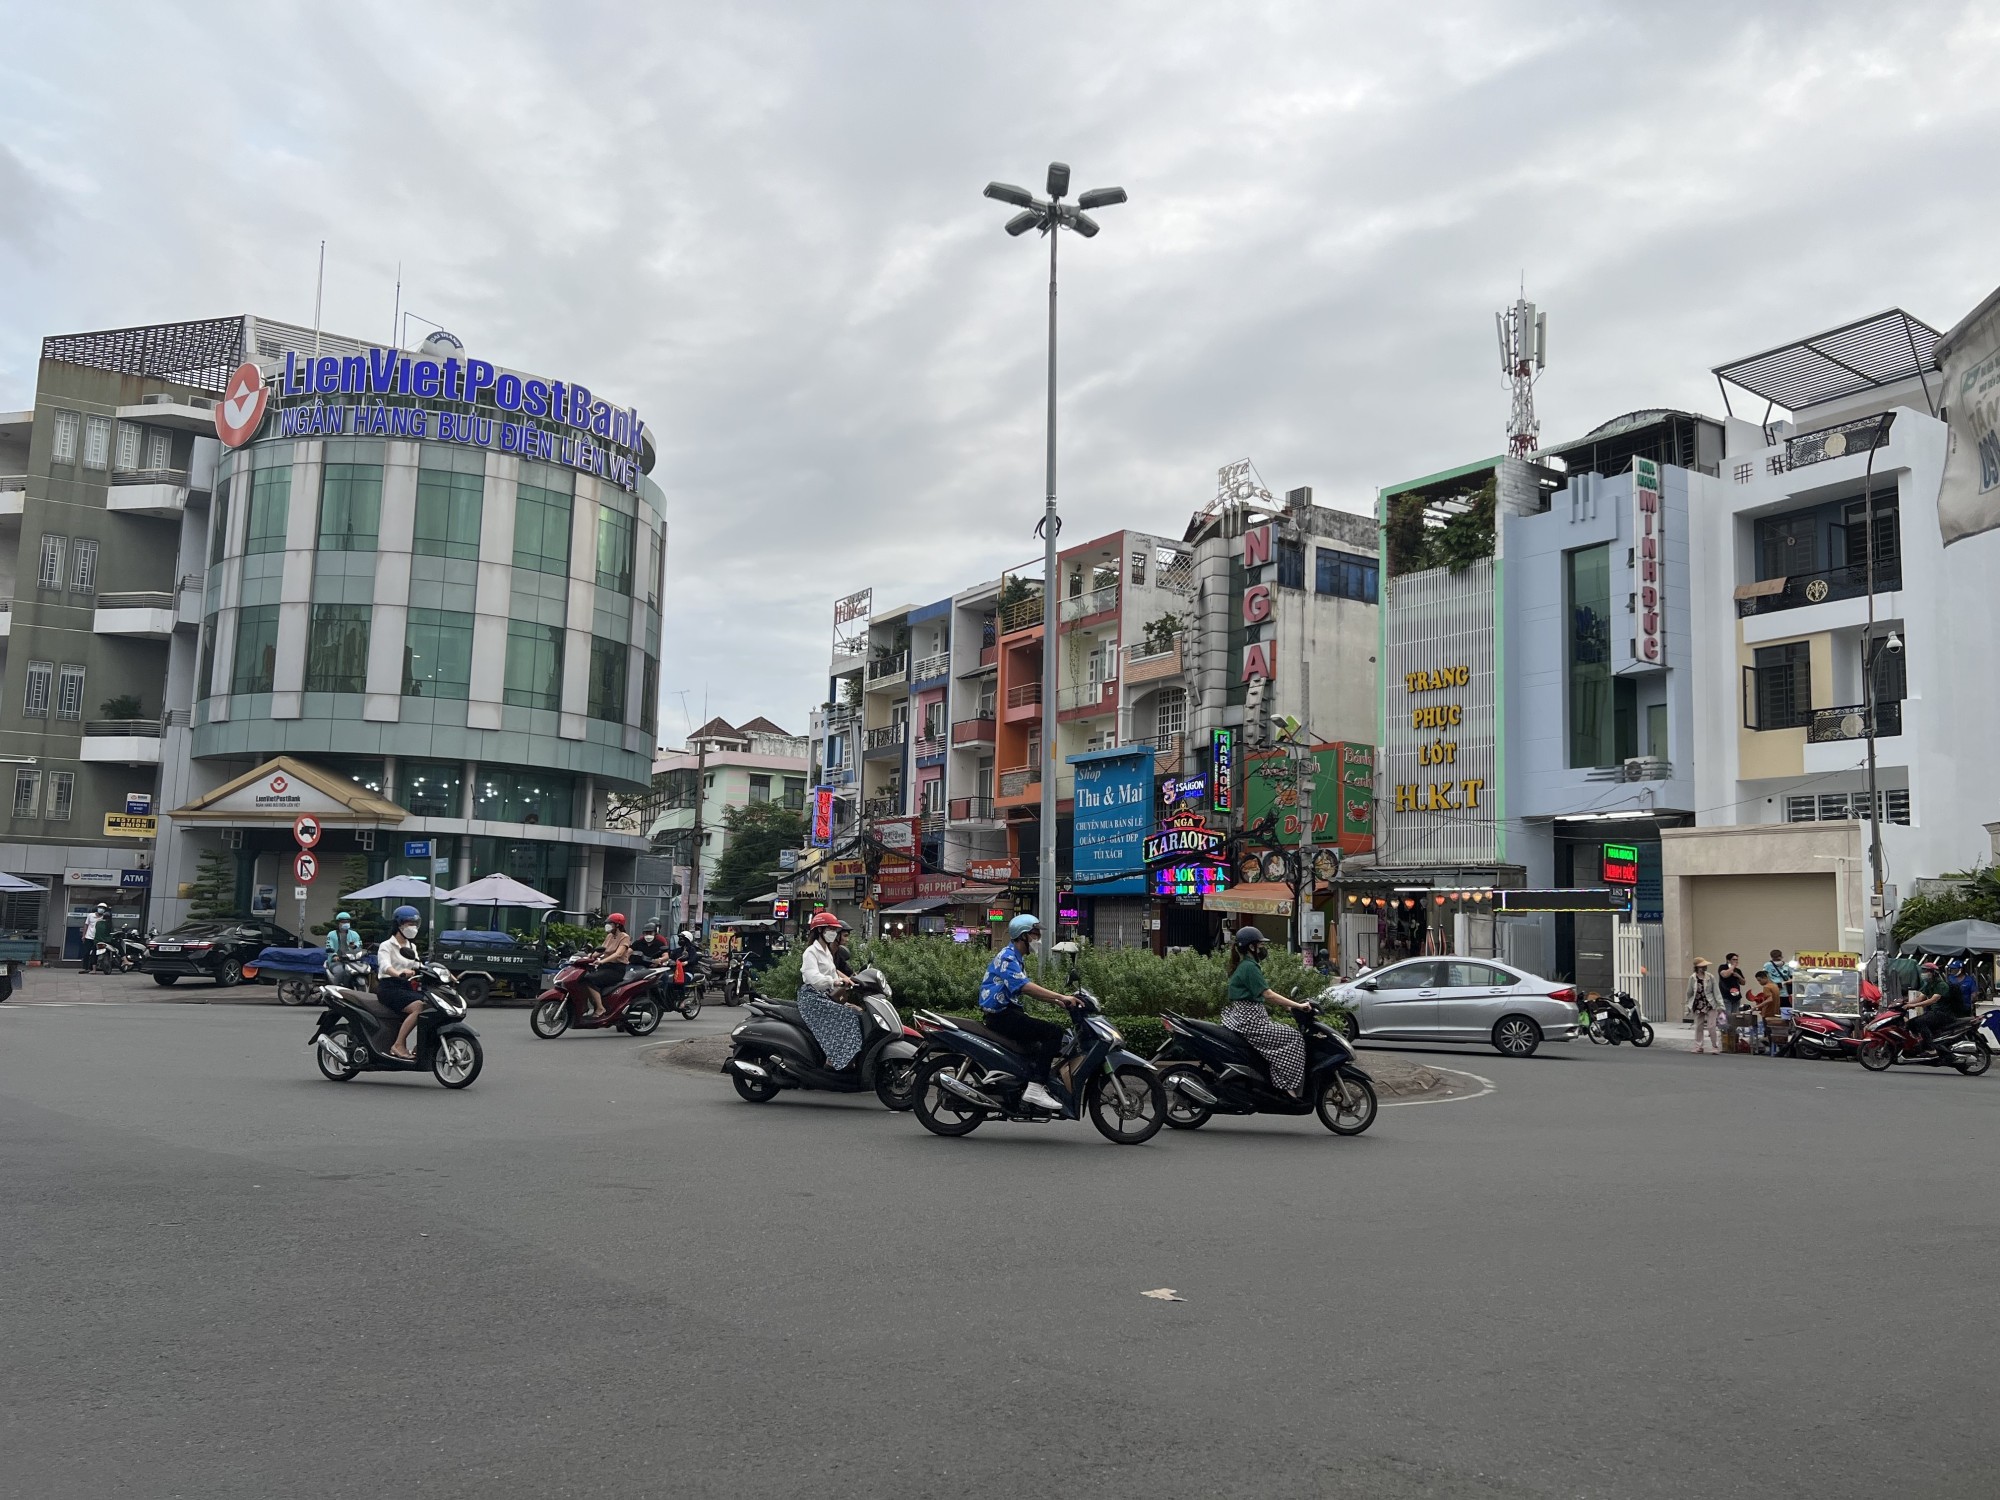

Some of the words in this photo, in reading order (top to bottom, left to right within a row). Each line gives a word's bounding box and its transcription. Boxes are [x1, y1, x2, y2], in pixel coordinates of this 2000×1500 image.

[283, 347, 646, 456] LienVietPostBank
[280, 399, 344, 436] NGÂN
[353, 398, 427, 438] HÀNG
[438, 410, 493, 447] BƯU
[501, 420, 554, 461] ĐIỆN
[561, 436, 604, 476] LIÊN
[608, 453, 643, 493] VIỆT
[1639, 459, 1655, 476] NHA
[1637, 473, 1657, 491] KHOA
[1639, 489, 1657, 583] MINH
[1241, 525, 1271, 682] NGA
[1642, 585, 1659, 660] ĐỨC
[1405, 665, 1470, 693] TRANG
[1412, 704, 1462, 731] PHỤC
[1344, 747, 1373, 767] Bánh
[1418, 738, 1457, 766] LÓT
[1078, 769, 1101, 783] Shop
[1219, 734, 1228, 806] KARAOKE
[1344, 770, 1373, 789] Canh
[1077, 788, 1100, 808] Thu
[1103, 785, 1115, 806] &
[1118, 782, 1143, 804] Mai
[1395, 779, 1484, 812] H.K.T
[1100, 820, 1114, 830] MUA
[1114, 816, 1128, 829] BÁN
[1173, 818, 1194, 828] NGA
[1094, 848, 1104, 860] TÚI
[1105, 847, 1123, 859] XÁCH
[1148, 831, 1219, 859] KARAOKE
[123, 874, 144, 882] ATM
[934, 881, 958, 892] PHÁT
[1798, 955, 1816, 967] CƠM
[1817, 952, 1836, 967] TẤM
[1837, 954, 1856, 969] ĐÊM
